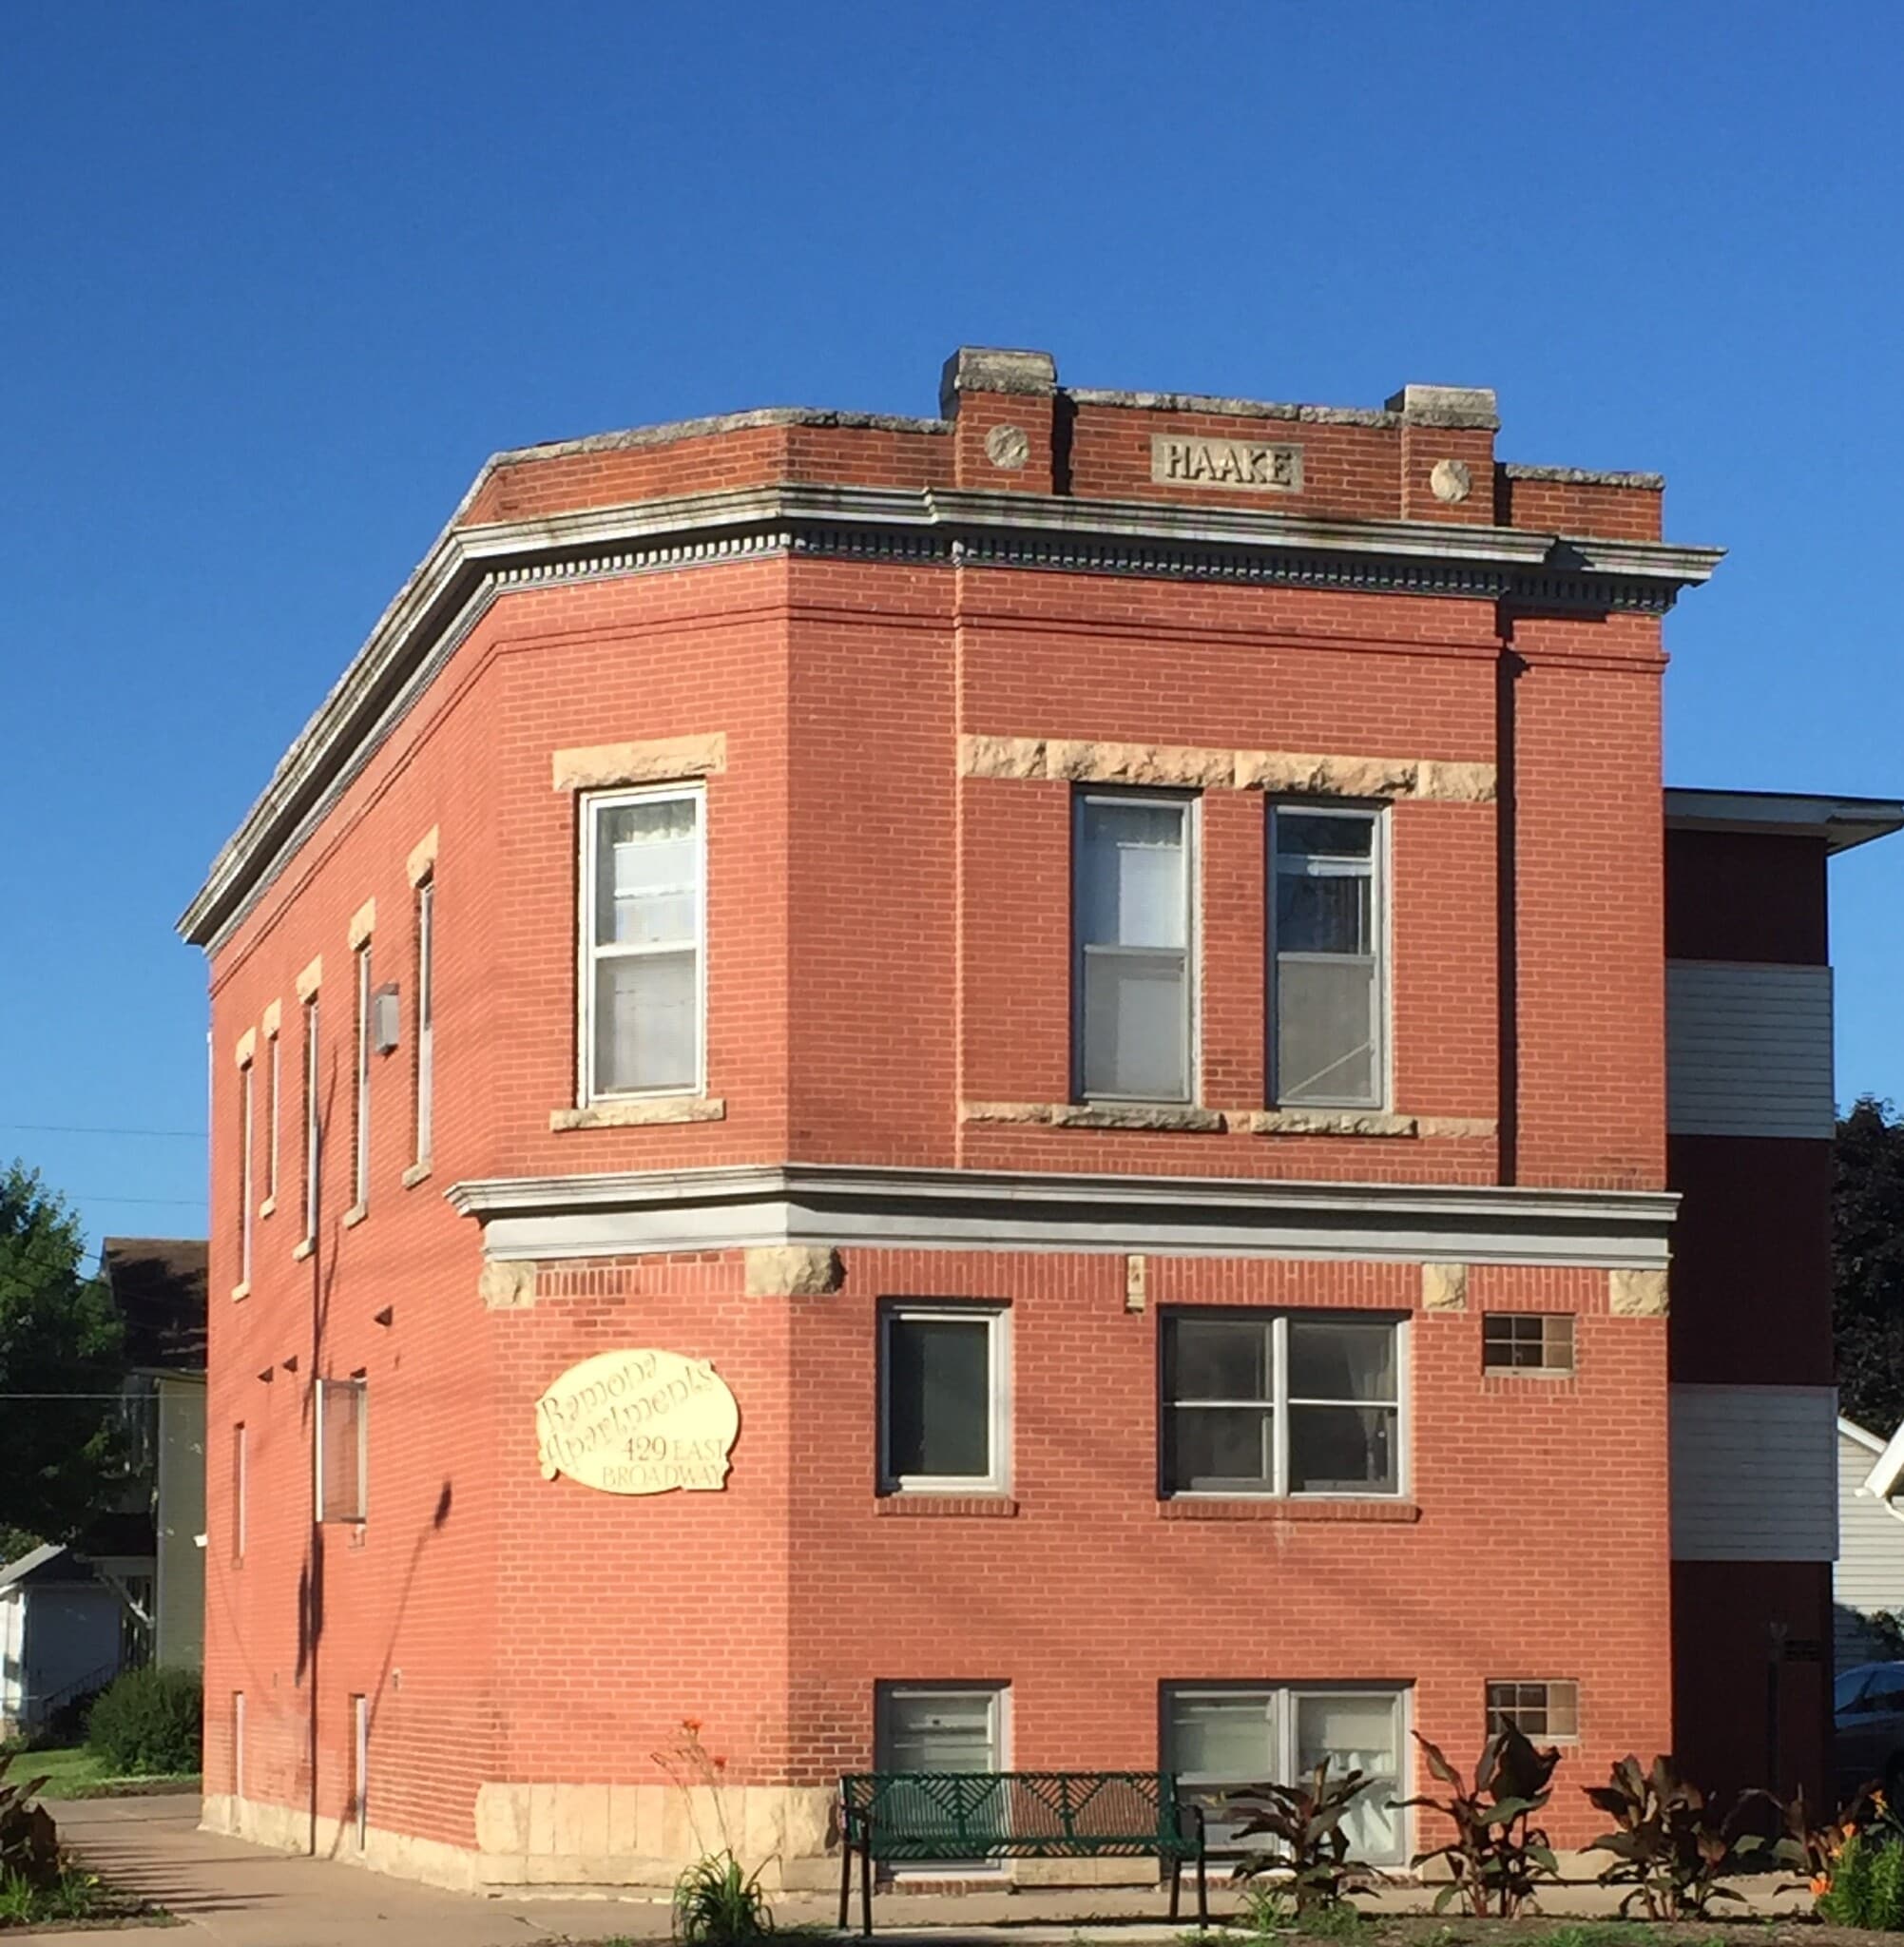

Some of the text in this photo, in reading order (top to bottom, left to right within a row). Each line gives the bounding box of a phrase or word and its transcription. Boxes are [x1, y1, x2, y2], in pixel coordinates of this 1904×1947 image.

[1164, 442, 1294, 486] HAAKE
[542, 1353, 657, 1431] Ramona
[547, 1365, 713, 1473] Apartments
[673, 1438, 726, 1461] EAST
[603, 1464, 724, 1487] BROADWAY
